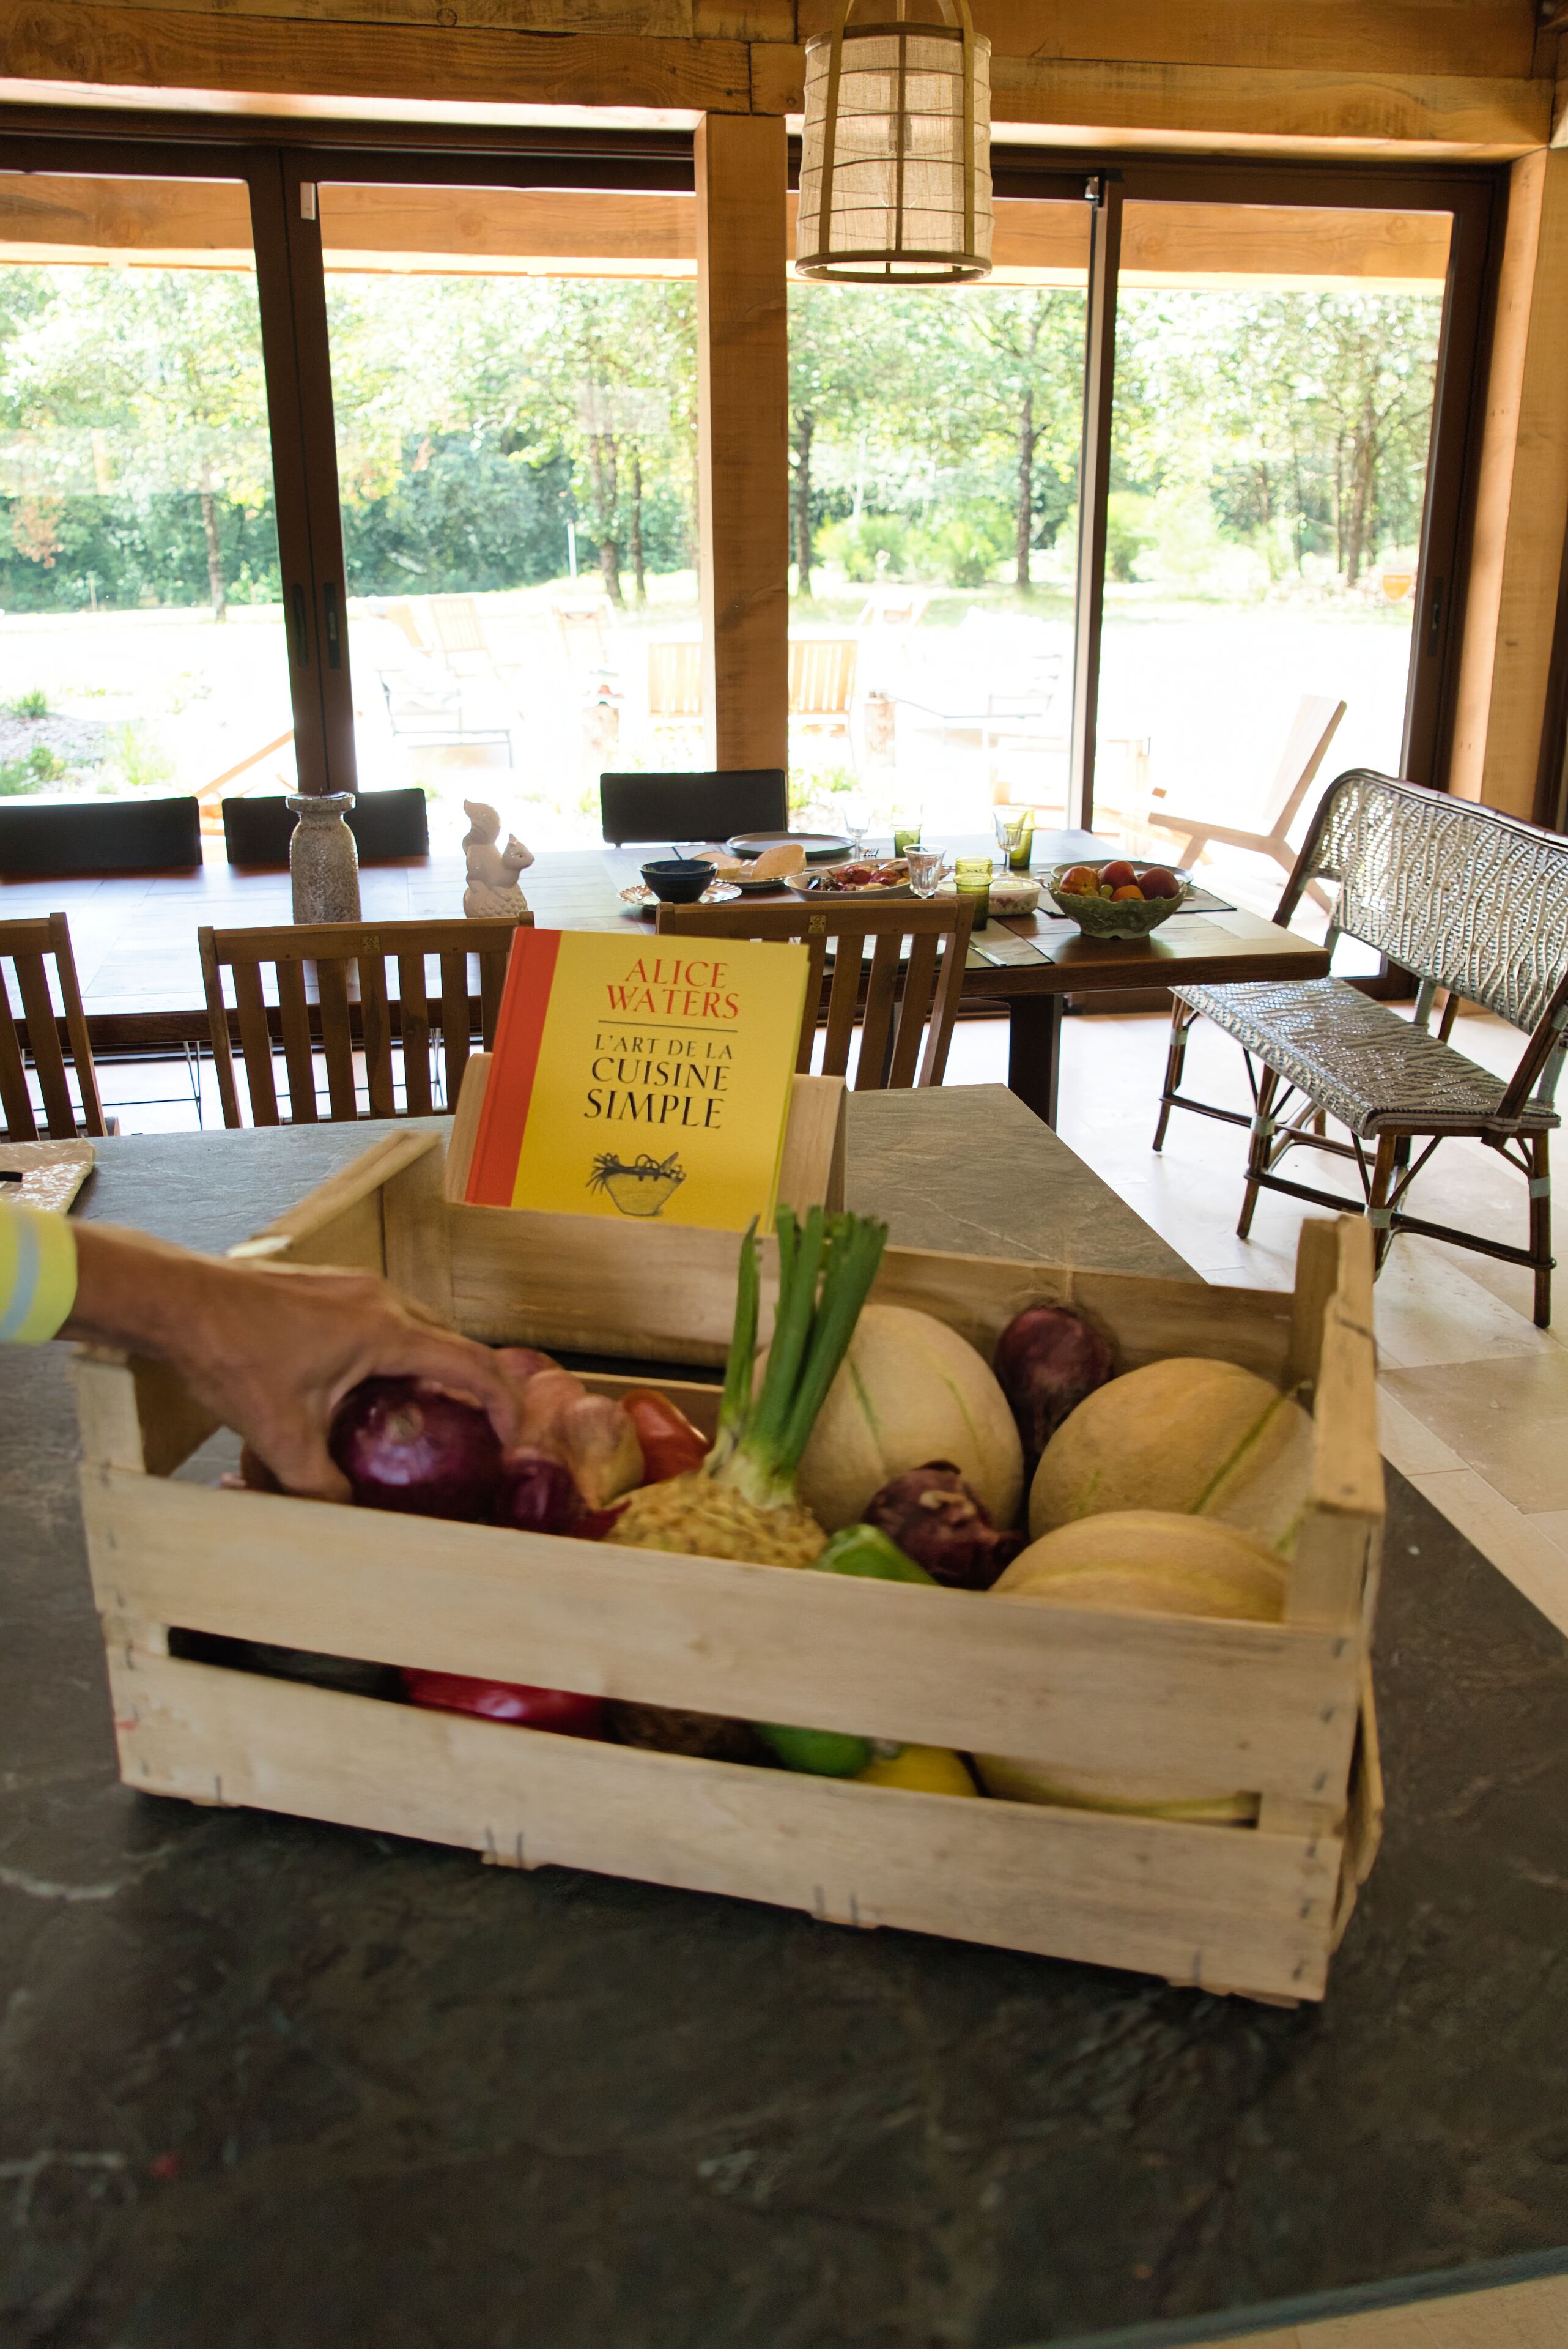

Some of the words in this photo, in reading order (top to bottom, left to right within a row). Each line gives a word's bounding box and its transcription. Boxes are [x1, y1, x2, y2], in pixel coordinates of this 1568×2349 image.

[624, 958, 729, 989] ALICE
[606, 985, 739, 1019] WATERS
[595, 1034, 658, 1055] L'ART
[667, 1039, 695, 1058] DE
[706, 1042, 733, 1060] LA
[591, 1057, 730, 1092] CUISINE
[583, 1088, 725, 1129] SIMPLE
